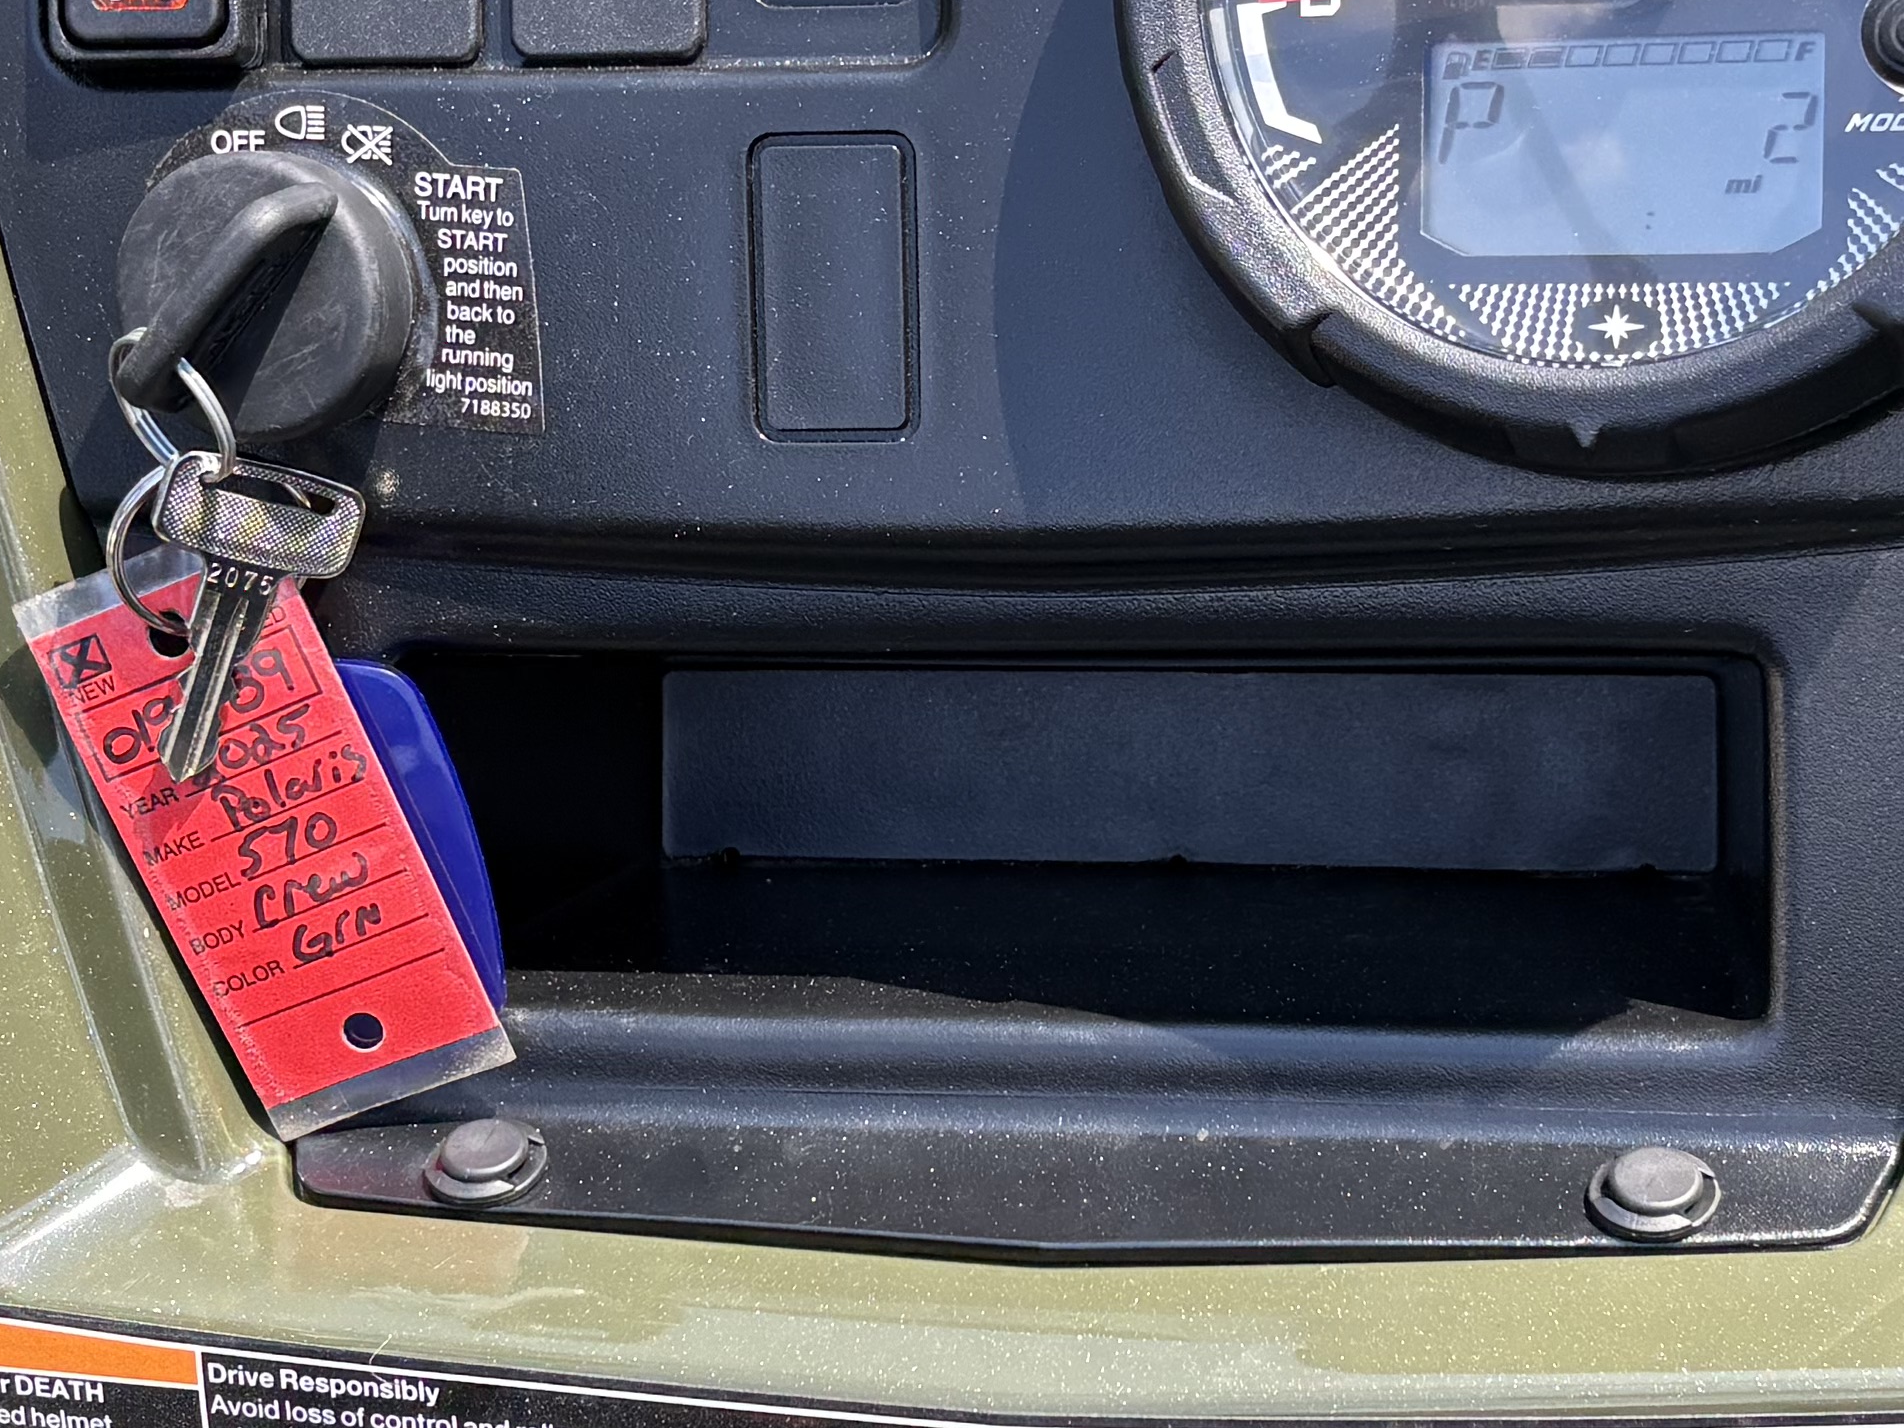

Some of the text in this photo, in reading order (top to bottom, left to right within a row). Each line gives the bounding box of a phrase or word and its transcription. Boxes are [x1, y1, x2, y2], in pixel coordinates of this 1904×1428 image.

[1438, 81, 1504, 164] P
[1764, 92, 1818, 164] 2
[210, 130, 265, 153] OFF
[414, 171, 503, 202] START
[1725, 175, 1763, 194] mi
[419, 201, 514, 230] Turn key to
[437, 228, 508, 253] START
[443, 255, 517, 278] position
[445, 279, 523, 301] and then
[447, 300, 515, 325] back to
[445, 324, 476, 345] the
[441, 348, 514, 372] running
[425, 368, 533, 399] light position
[461, 399, 532, 419] 7188350
[206, 562, 275, 596] 2075
[72, 676, 115, 704] NEW
[193, 704, 310, 787] 025
[120, 788, 180, 819] YEAR
[143, 830, 204, 866] MAKE
[238, 812, 337, 877] 570
[165, 872, 241, 911] MODEL
[254, 852, 368, 929] Crew
[189, 920, 245, 956] BODY
[213, 960, 285, 997] COLOR
[15, 1374, 106, 1403] DEATH
[207, 1362, 439, 1407] Drive Responsibly
[211, 1394, 280, 1420] Avoid
[285, 1400, 336, 1425] loss
[341, 1407, 364, 1427] of
